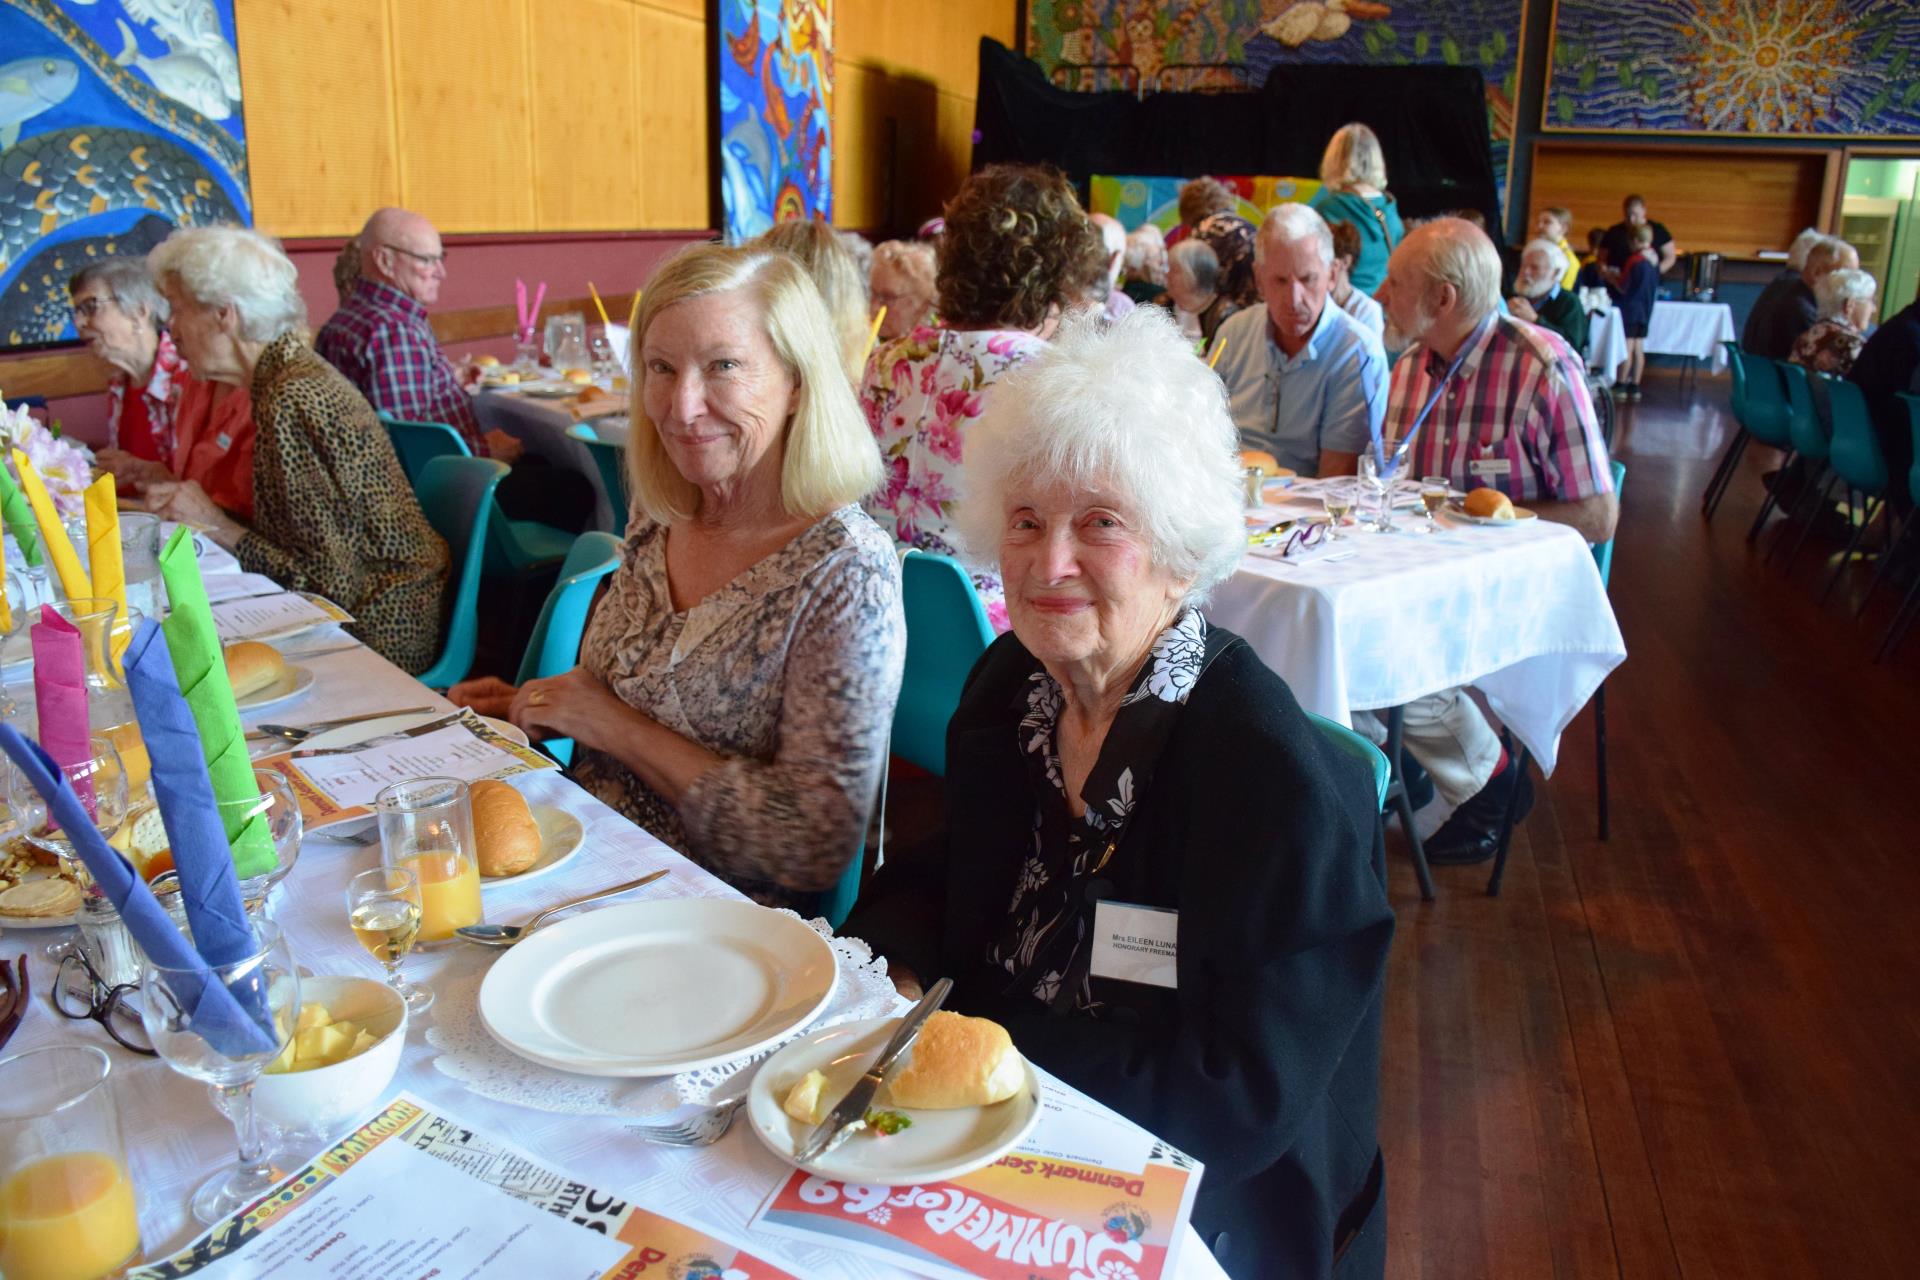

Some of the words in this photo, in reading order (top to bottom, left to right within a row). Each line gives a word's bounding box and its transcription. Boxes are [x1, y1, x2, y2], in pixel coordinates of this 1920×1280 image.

[1112, 934, 1125, 942] Mrs
[1127, 936, 1154, 946] EILEEN
[1112, 943, 1149, 953] HONORARY
[1149, 948, 1177, 957] FREEMA
[1038, 1162, 1146, 1198] Denmark
[547, 1181, 587, 1218] RTH
[326, 1212, 351, 1231] Ginger
[923, 1188, 1145, 1280] SUMMER
[304, 1231, 347, 1262] Dessert
